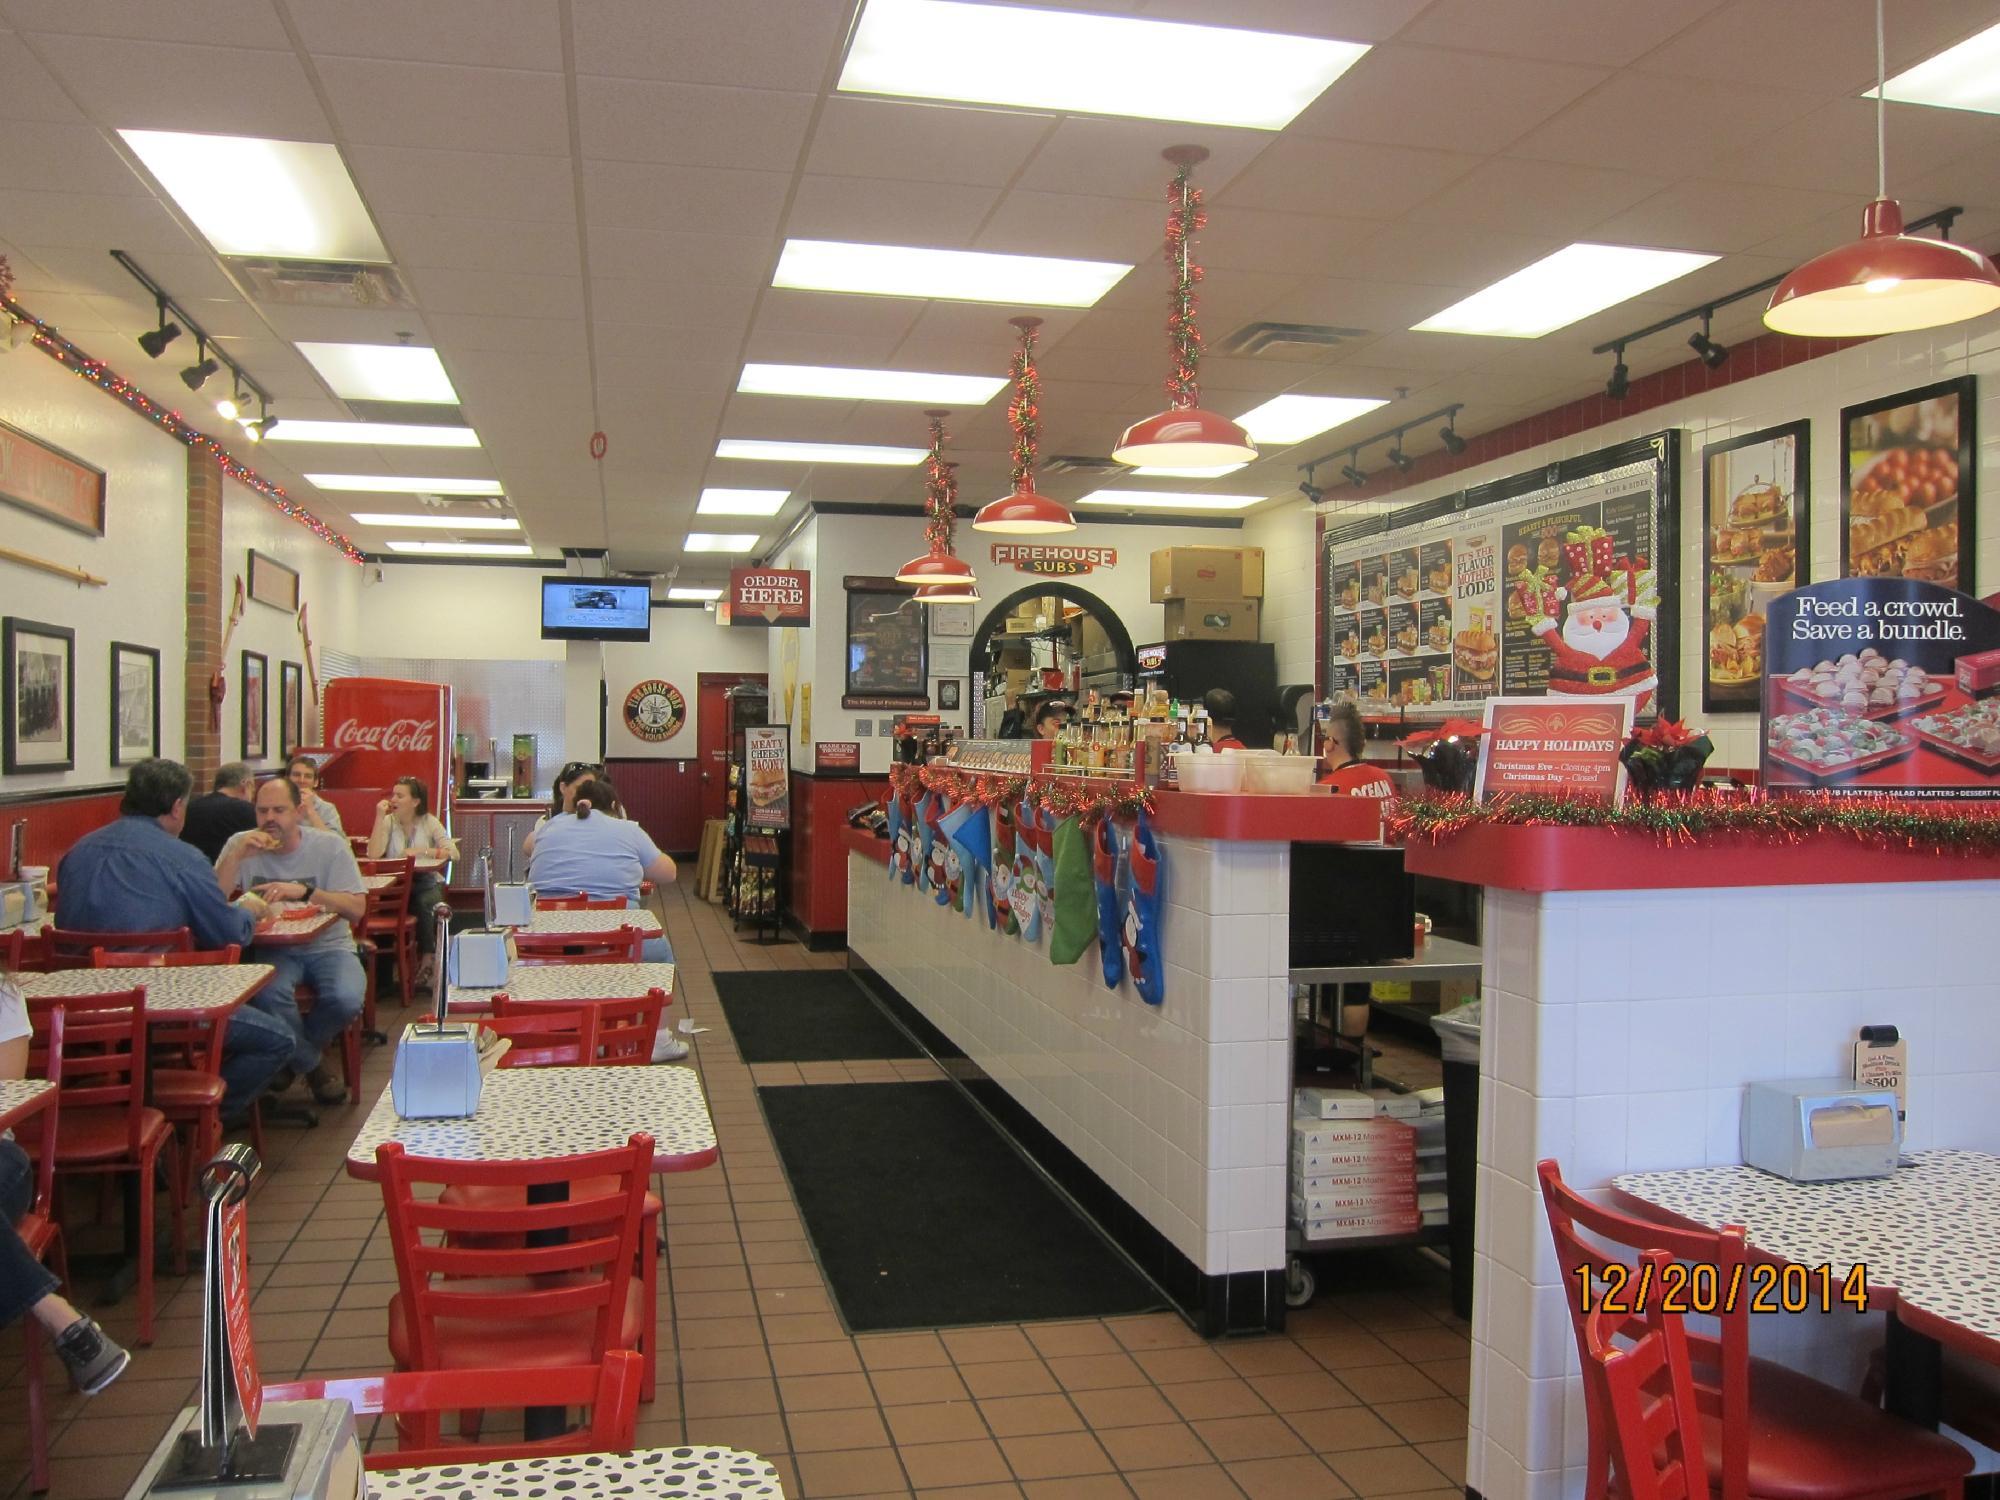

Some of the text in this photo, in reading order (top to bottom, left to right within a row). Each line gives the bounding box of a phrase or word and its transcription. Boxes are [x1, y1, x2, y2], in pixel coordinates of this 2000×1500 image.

[995, 546, 1114, 569] FIREHOUSE
[1033, 561, 1077, 573] SUBS
[1457, 555, 1494, 574] FLAVOR
[743, 575, 800, 588] ORDER
[1457, 567, 1495, 586] MOTHER
[1457, 578, 1495, 599] LODE
[740, 588, 803, 605] HERE
[1795, 597, 1964, 618] Feed a crowd.
[1792, 619, 1967, 640] Save a bundle.
[334, 718, 436, 751] Coca-Cola
[751, 738, 784, 749] MEATY
[1495, 739, 1615, 752] HAPPY HOLIDAYS
[751, 748, 785, 759] CHEESY
[751, 759, 785, 771] BACONY
[1493, 762, 1535, 770] Christmas
[1537, 762, 1553, 770] Eve
[1560, 763, 1591, 773] Closing
[1592, 764, 1611, 774] 4pm
[1503, 772, 1545, 780] Christmas
[1547, 773, 1564, 782] Day
[1572, 773, 1598, 781] Closed
[1889, 789, 1916, 797] SALAD
[1332, 1133, 1362, 1142] MXM-12
[1331, 1155, 1361, 1164] MXM-12
[1331, 1177, 1361, 1186] MXM-12
[1335, 1198, 1364, 1207] MXM-12
[1336, 1219, 1365, 1227] MXM-12
